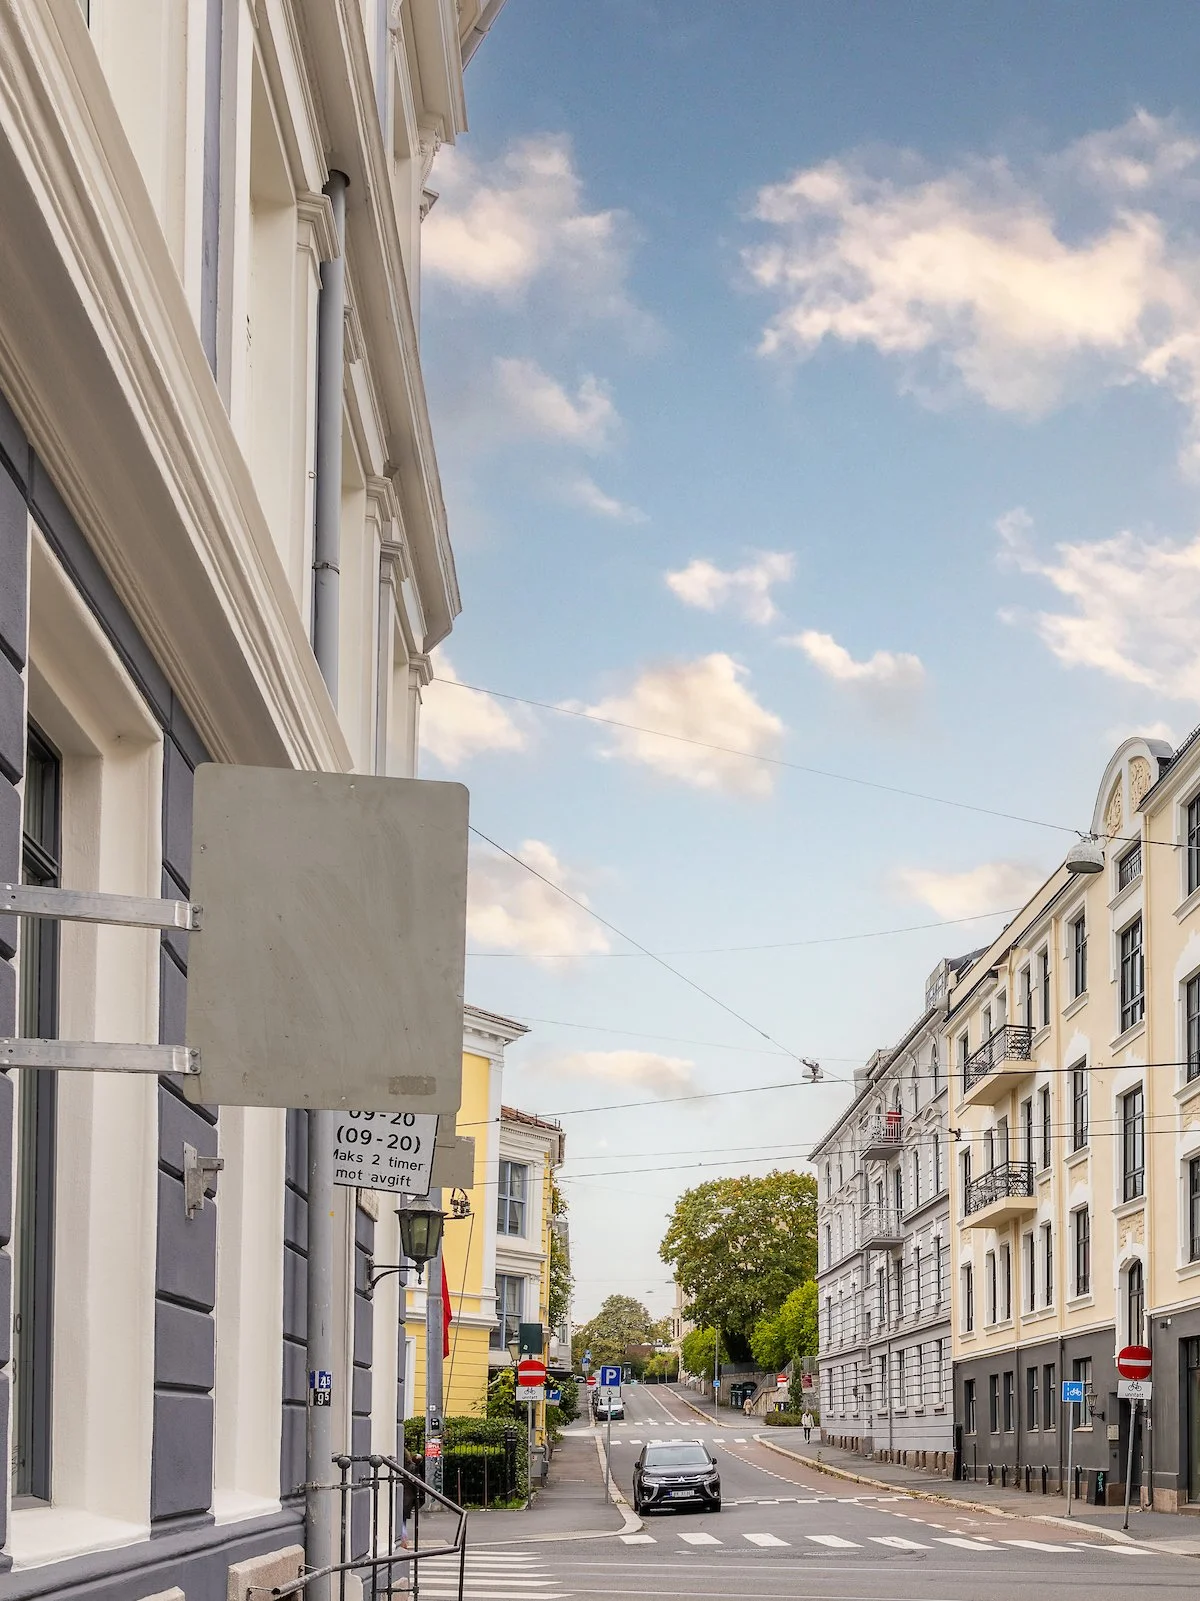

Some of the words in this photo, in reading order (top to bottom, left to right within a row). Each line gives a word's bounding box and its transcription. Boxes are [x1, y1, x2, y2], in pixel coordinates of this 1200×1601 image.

[336, 1125, 421, 1154] (09-20)
[371, 1154, 381, 1166] 2
[388, 1155, 425, 1172] timer
[335, 1168, 363, 1181] mot
[370, 1172, 412, 1188] avgift
[605, 1369, 617, 1385] P
